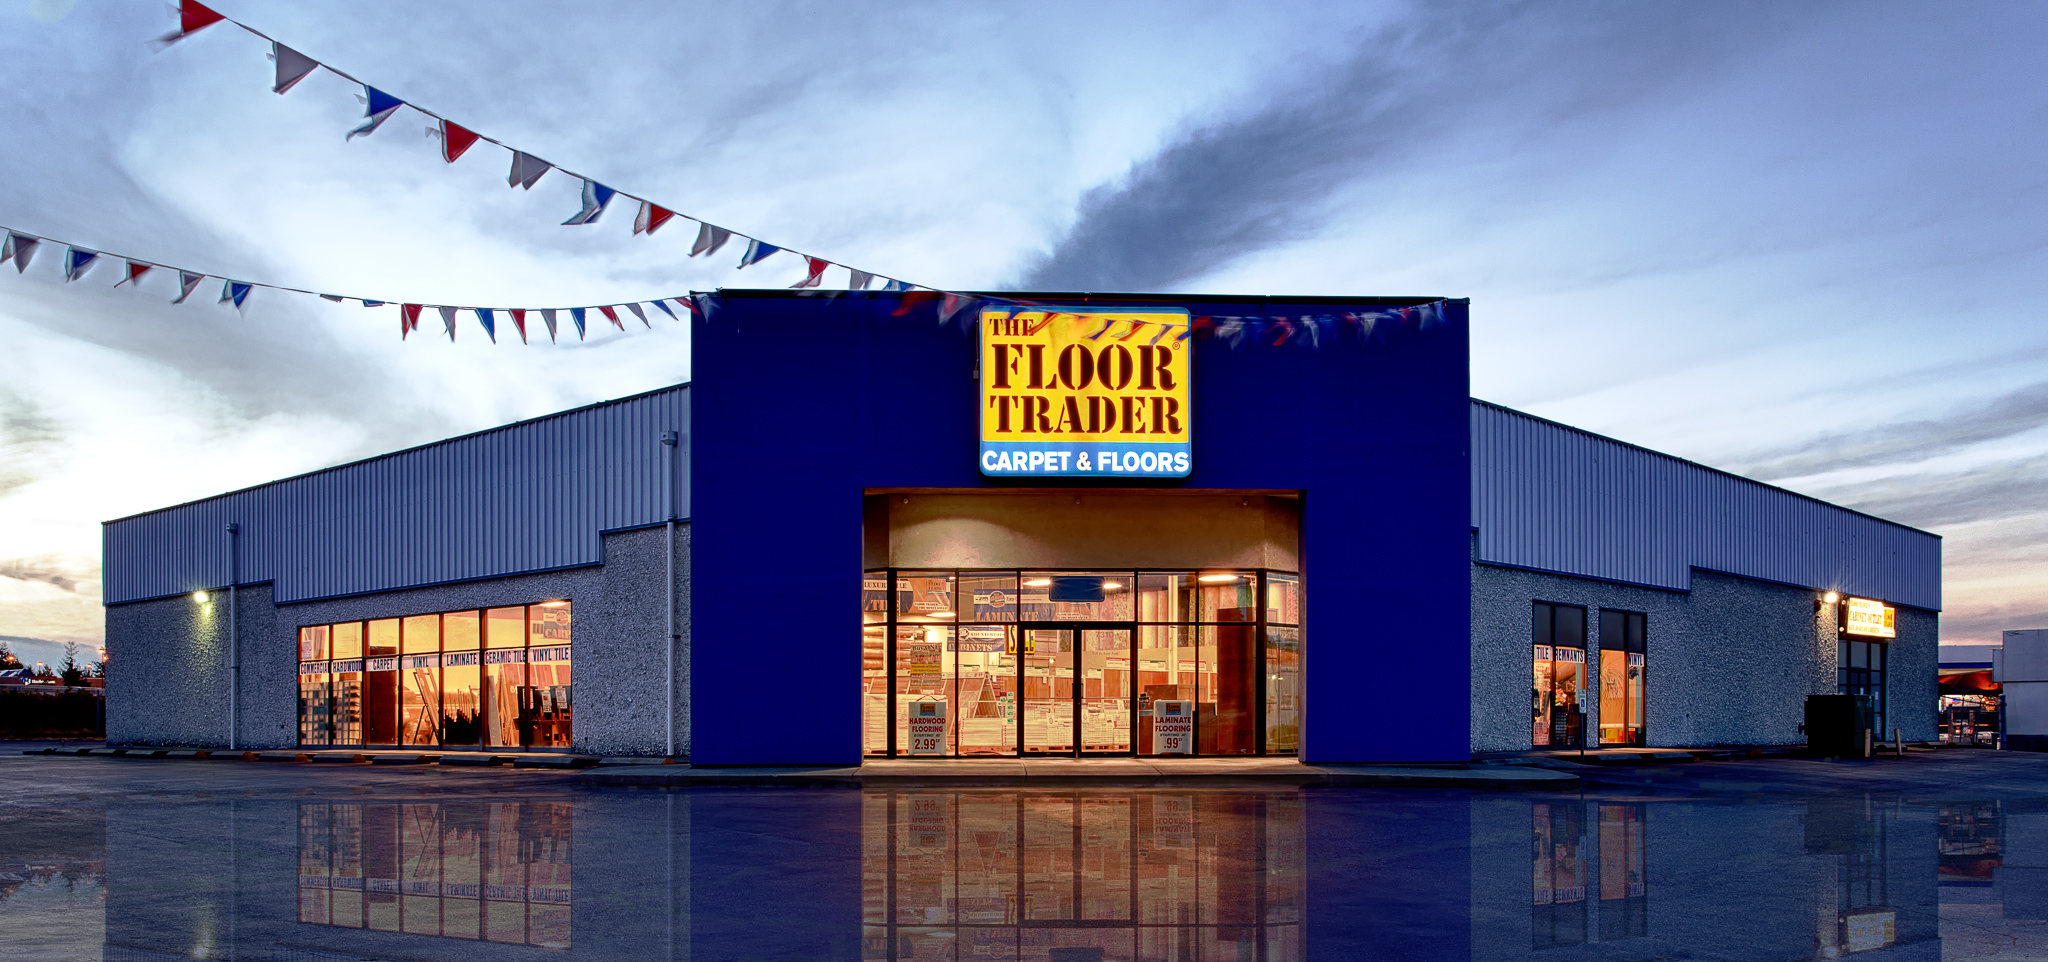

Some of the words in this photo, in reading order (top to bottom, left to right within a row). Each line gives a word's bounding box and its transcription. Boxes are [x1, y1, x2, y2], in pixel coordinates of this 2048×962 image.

[989, 318, 1034, 336] THE
[991, 343, 1177, 391] FLOOR
[989, 395, 1183, 435] TRADER
[982, 450, 1071, 471] CARPET
[1076, 451, 1092, 471] &
[1098, 451, 1190, 472] FLOORS
[976, 611, 1039, 622] LAMINTE
[1849, 610, 1867, 623] CABINET
[545, 628, 571, 639] CARP
[533, 649, 552, 662] VINYL
[555, 647, 569, 660] TILE
[948, 644, 993, 652] CBINETS
[1536, 646, 1549, 660] TILE
[412, 655, 429, 668] VINYL
[446, 652, 477, 666] LAMINATE
[485, 651, 511, 664] CERAMIC
[514, 650, 526, 663] TILE
[1555, 648, 1584, 663] REMNANTS
[300, 663, 329, 674] COMMERCIA
[333, 661, 363, 672] HARDWOOD
[372, 658, 394, 671] CARPET
[915, 739, 936, 750] 2.99
[1163, 737, 1179, 749] .99
